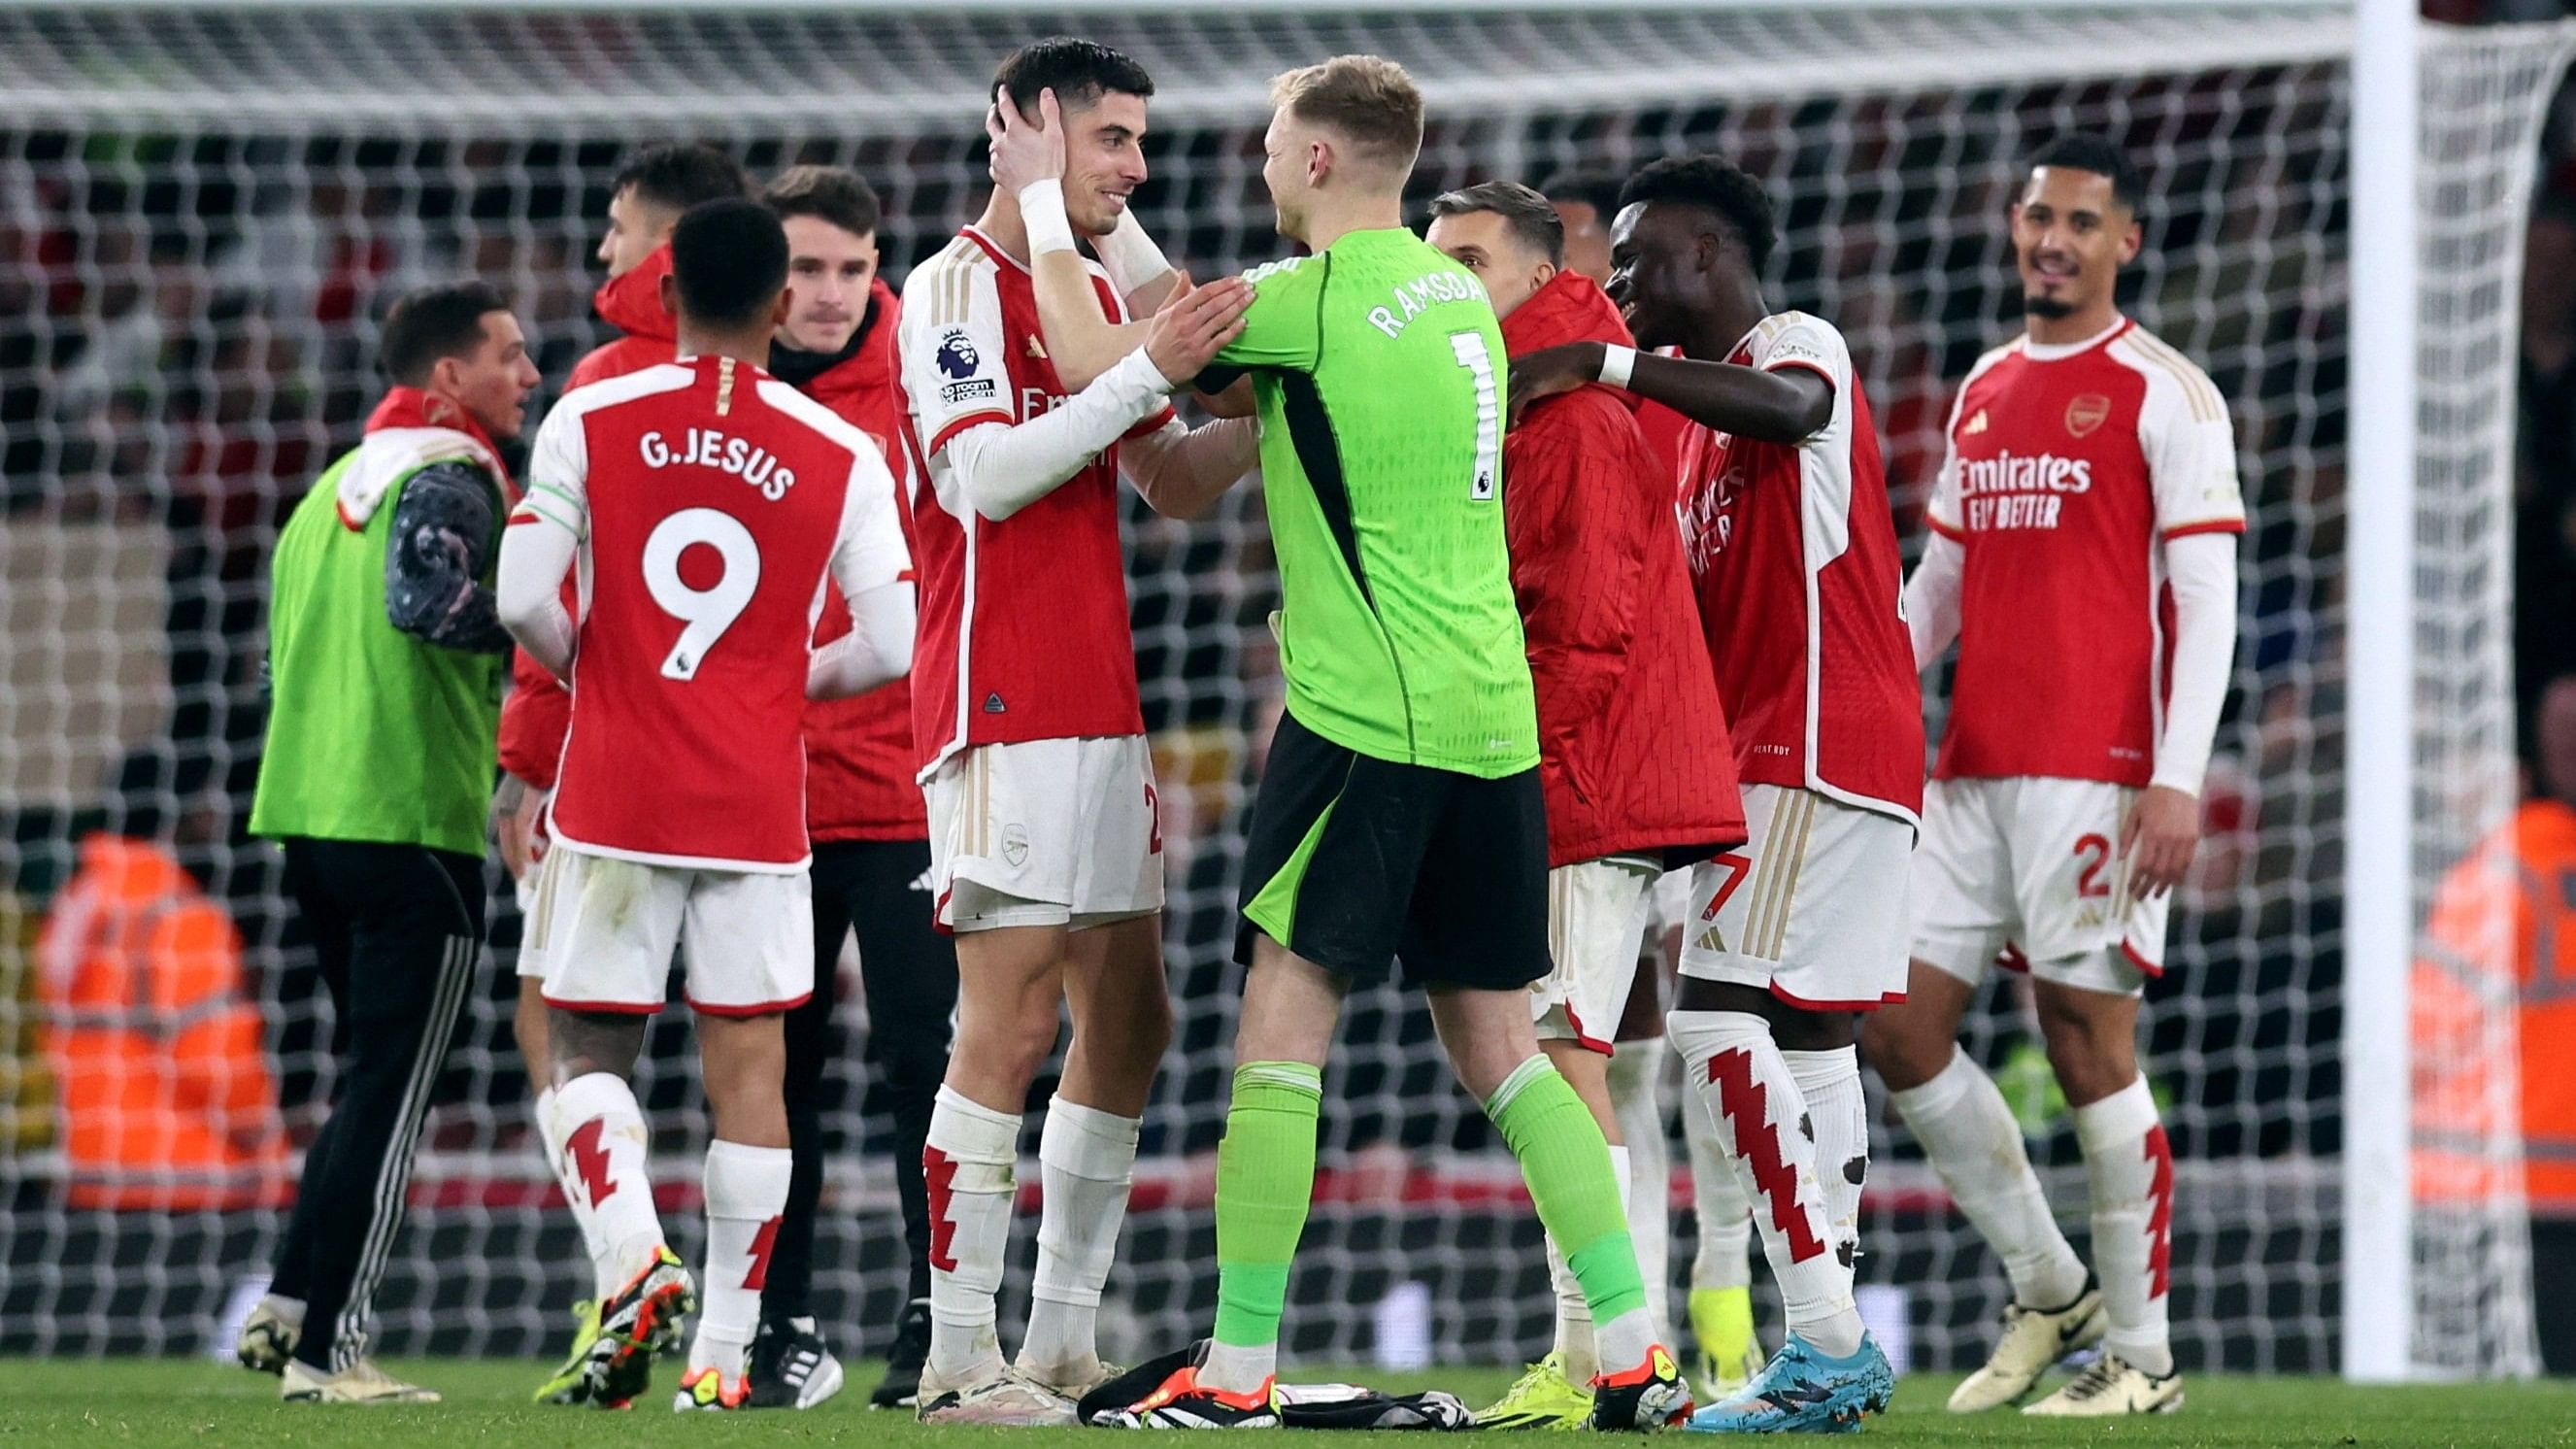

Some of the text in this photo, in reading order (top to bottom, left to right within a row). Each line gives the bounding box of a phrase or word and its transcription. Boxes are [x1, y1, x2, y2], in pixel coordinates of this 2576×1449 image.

[955, 381, 989, 392] room
[1450, 331, 1498, 500] 1
[640, 427, 796, 502] G.JESUS
[1956, 449, 2091, 493] Emirates
[642, 506, 761, 681] 9
[1700, 851, 1752, 922] 7
[2073, 832, 2110, 897] 2
